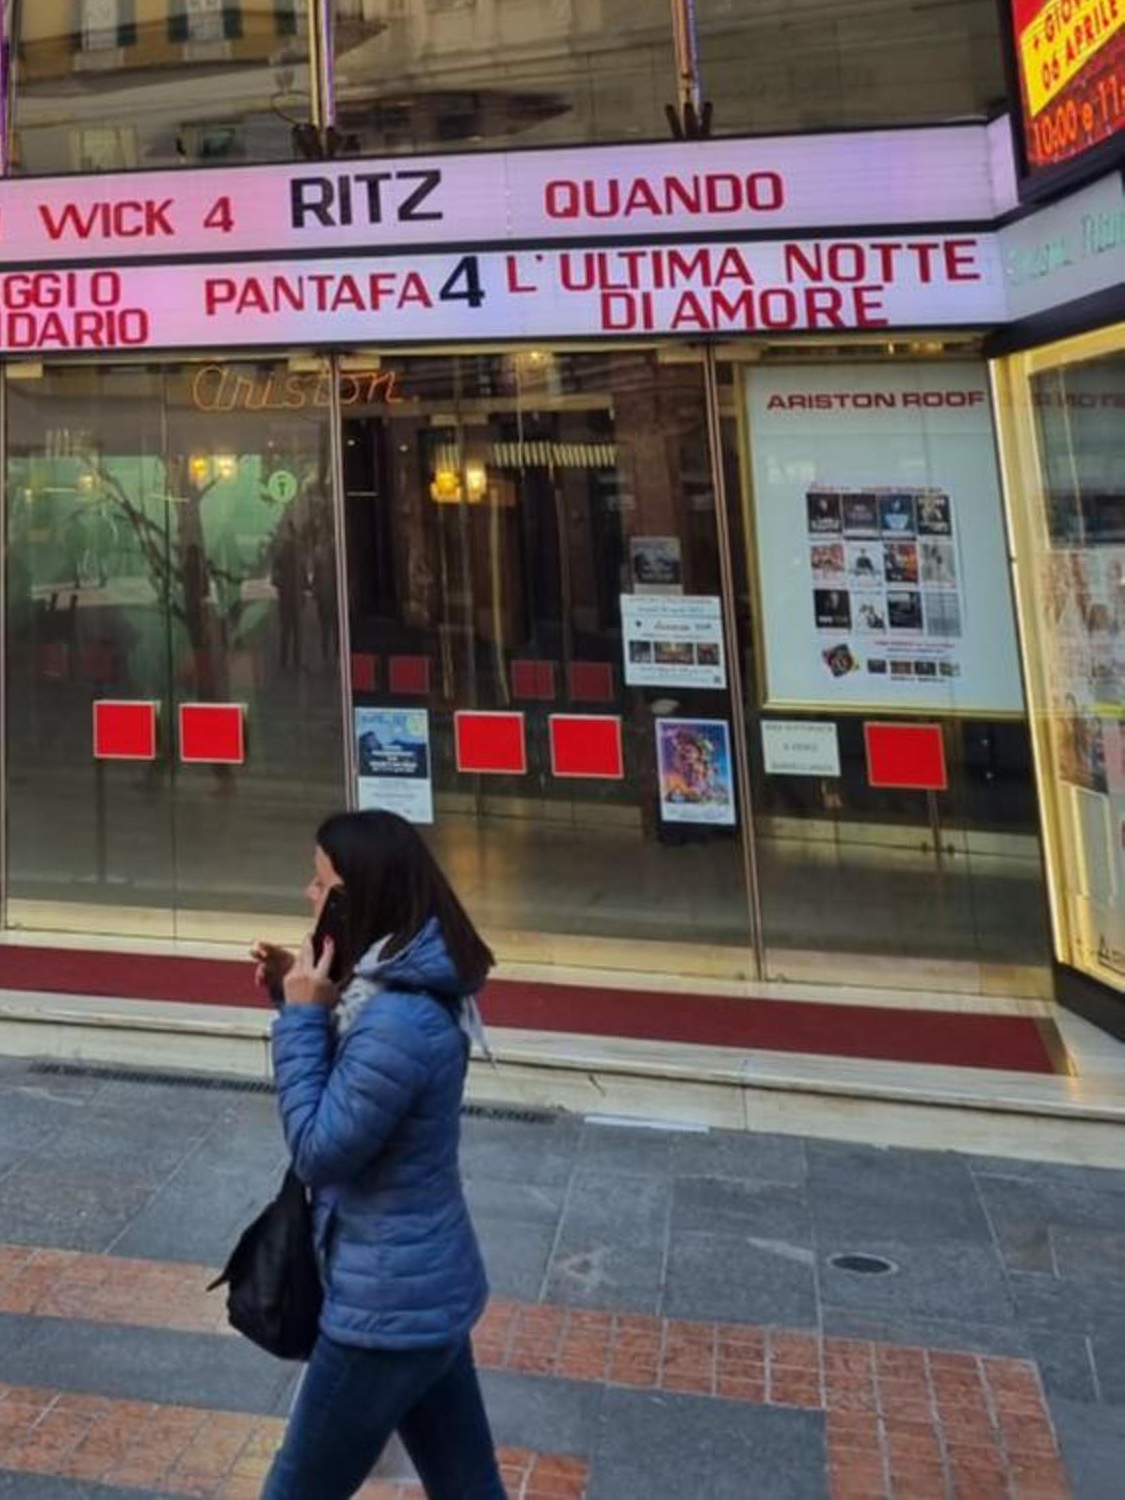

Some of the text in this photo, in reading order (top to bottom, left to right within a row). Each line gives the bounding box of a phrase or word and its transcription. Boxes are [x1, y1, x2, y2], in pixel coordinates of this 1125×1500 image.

[1034, 100, 1077, 160] 10:00
[38, 199, 175, 240] WICK
[203, 197, 233, 233] 4
[290, 169, 443, 228] RITZ
[544, 171, 784, 219] QUANDO
[439, 255, 485, 309] 4
[506, 246, 754, 293] L'ULTIMA
[785, 239, 982, 284] NOTTE
[204, 270, 433, 316] PANTAFA
[670, 285, 890, 330] AMORE
[766, 390, 988, 411] ARISTON ROOF
